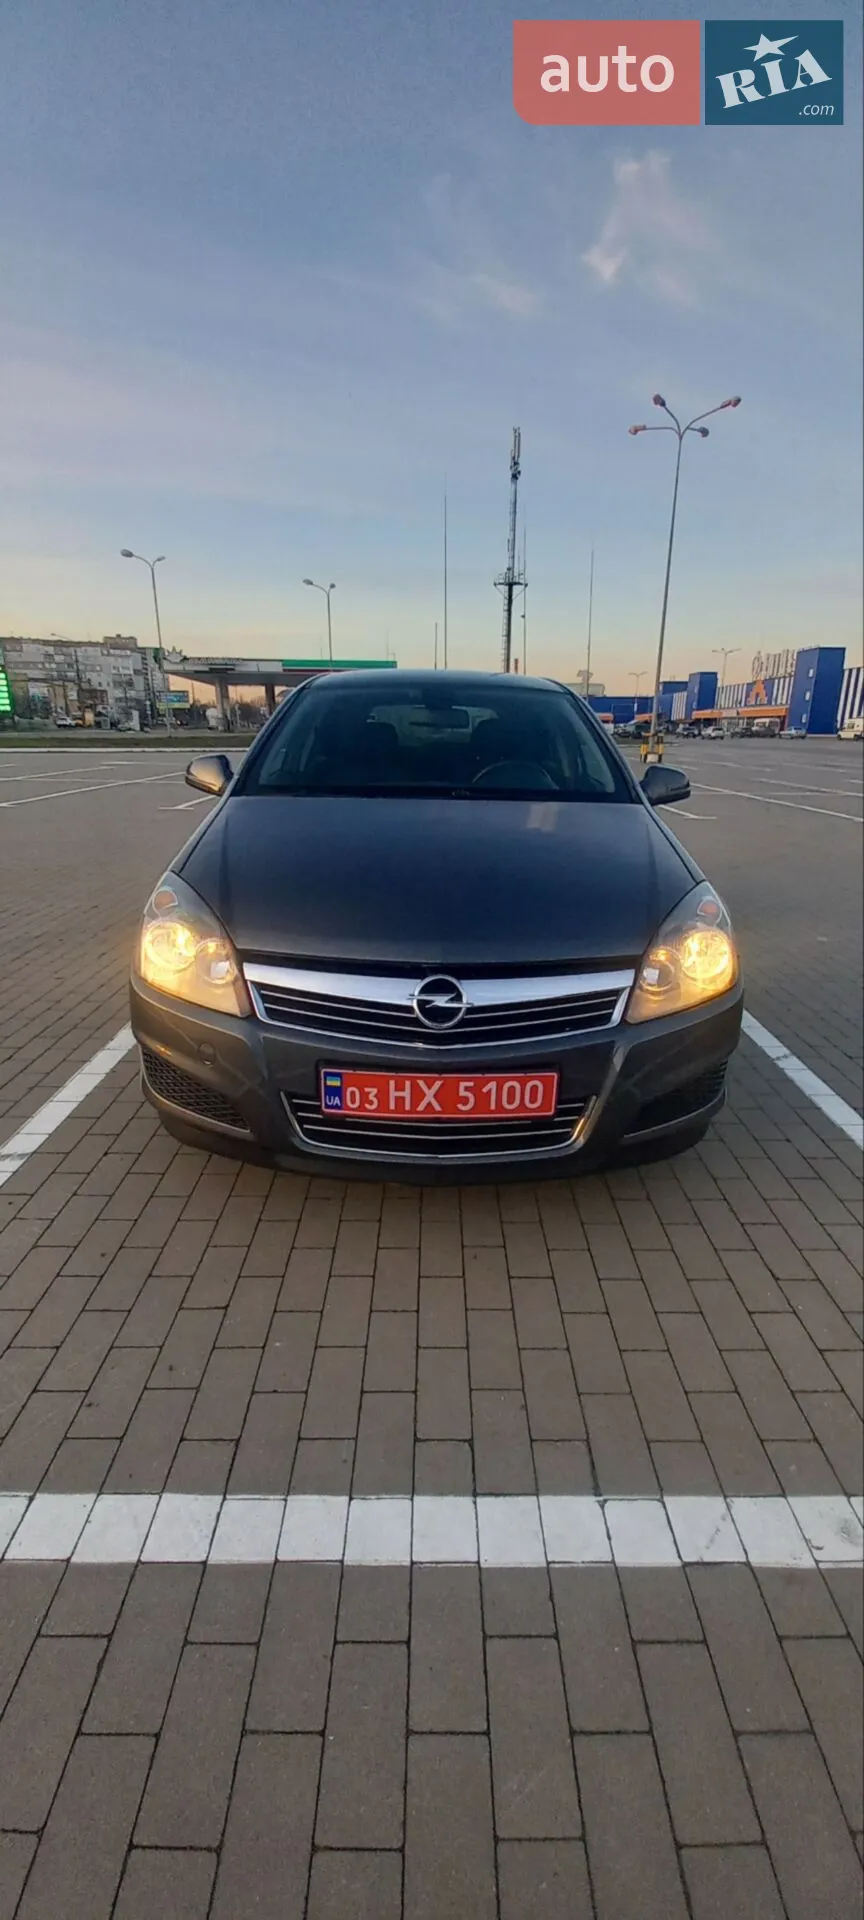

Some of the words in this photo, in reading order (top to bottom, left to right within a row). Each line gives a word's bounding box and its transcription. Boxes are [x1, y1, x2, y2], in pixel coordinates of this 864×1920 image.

[325, 1095, 342, 1106] UA
[345, 1086, 379, 1110] 03
[388, 1079, 444, 1112] HX
[456, 1079, 544, 1111] 5100
